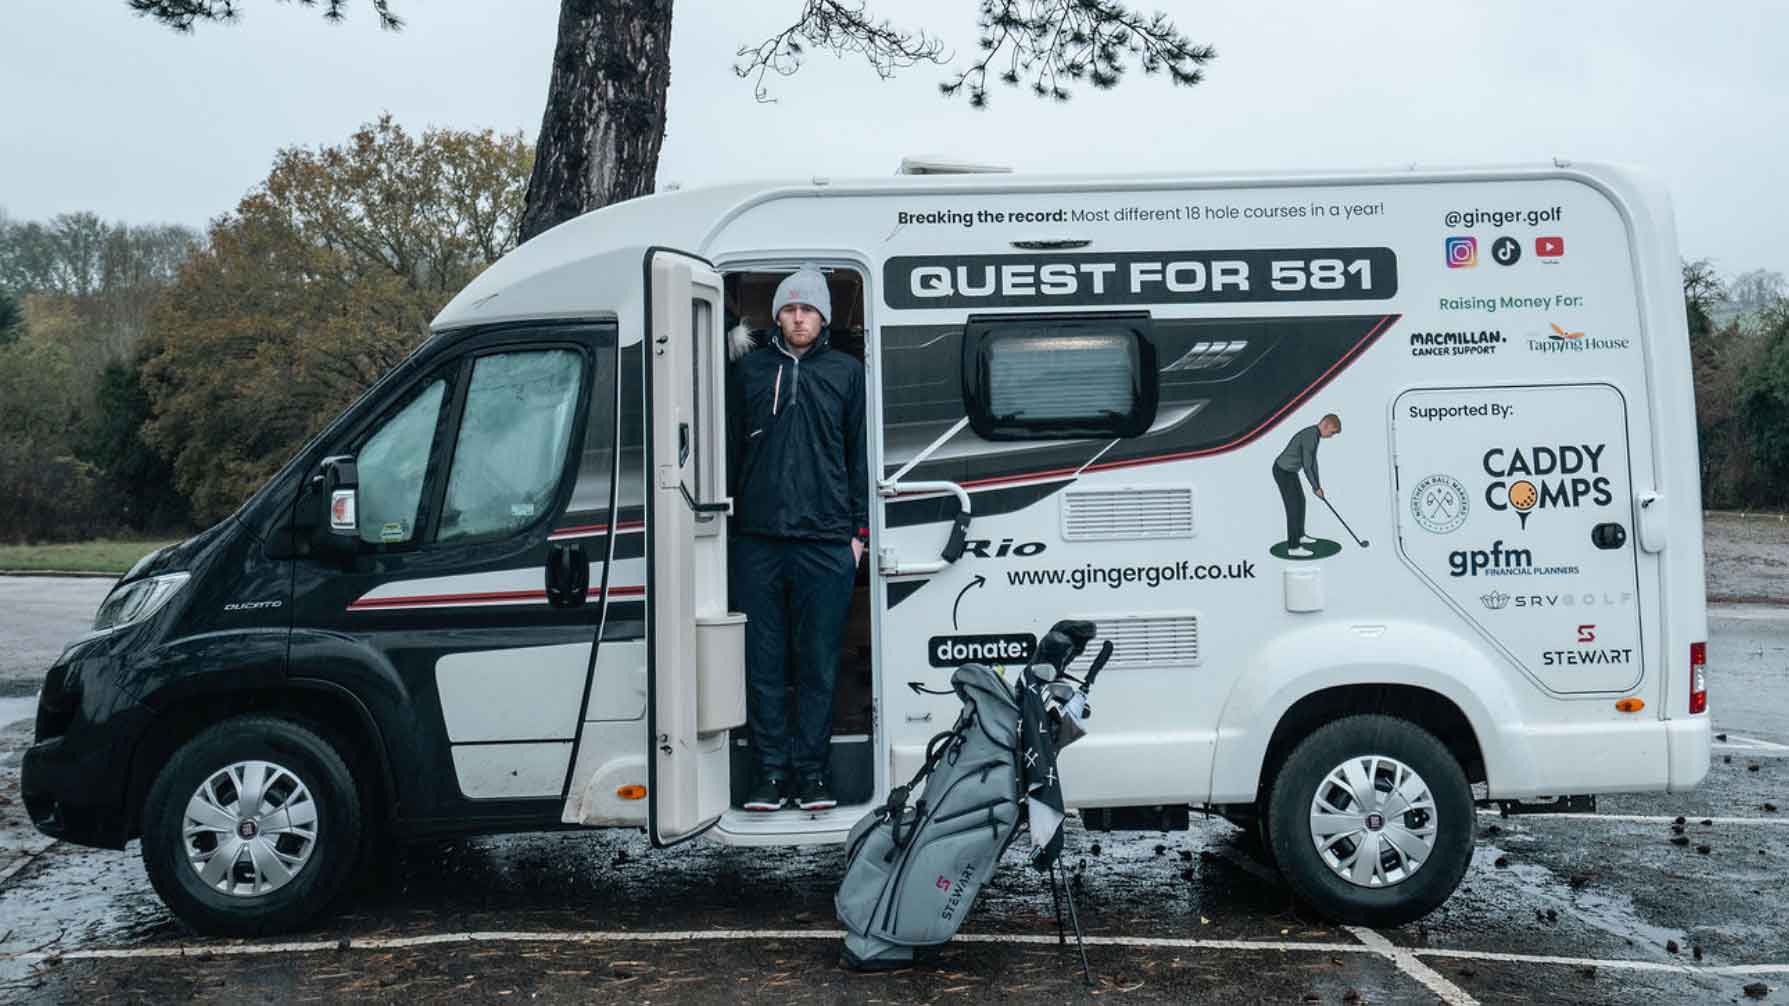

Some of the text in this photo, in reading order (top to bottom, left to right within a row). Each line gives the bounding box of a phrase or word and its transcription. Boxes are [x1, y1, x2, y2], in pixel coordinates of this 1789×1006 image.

[898, 202, 1384, 227] Breaking the record: Most different 18 hole courses in a year!
[1445, 206, 1563, 228] @ginger.golf
[910, 259, 1373, 297] QUEST FOR 581
[1440, 295, 1583, 312] Raising Money For:
[1412, 345, 1496, 356] CANCER SUPPORT
[1528, 337, 1629, 353] Tapping House
[1409, 403, 1513, 421] Supported By:
[1483, 444, 1606, 477] CADDY
[1485, 477, 1613, 511] COMPS
[960, 538, 1046, 558] Rio
[1448, 540, 1532, 577] gpfm
[1007, 560, 1255, 590] www.gingergolf.co.uk
[1485, 566, 1580, 576] FINANCIAL PLANNERS
[1515, 592, 1632, 607] SRV GOLF
[937, 639, 1028, 661] donate:
[1543, 649, 1632, 665] STEWART
[942, 863, 976, 921] STEWART
